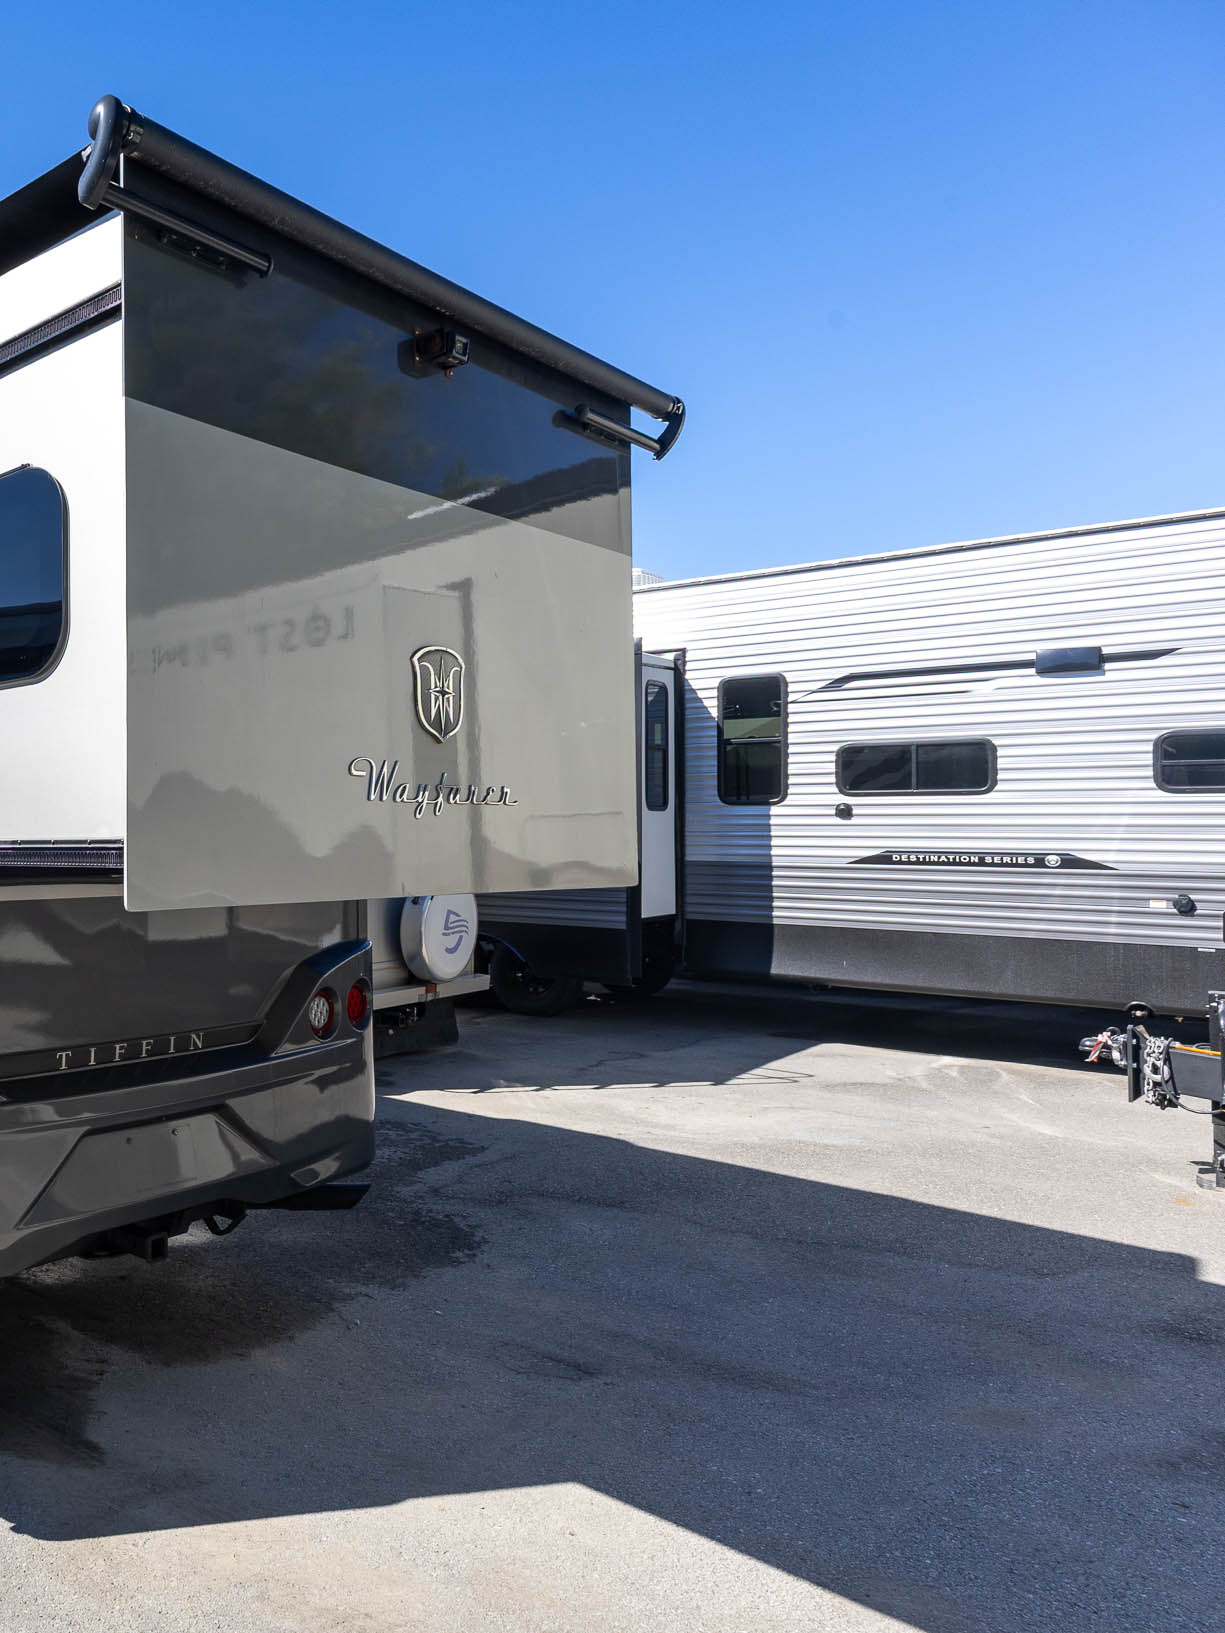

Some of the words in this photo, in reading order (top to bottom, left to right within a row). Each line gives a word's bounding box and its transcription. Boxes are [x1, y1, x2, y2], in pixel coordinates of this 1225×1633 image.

[348, 757, 519, 820] Wayfarer
[891, 854, 980, 863] DESTINATION
[984, 855, 1036, 864] SERIES
[56, 1032, 205, 1070] TIFFIN
